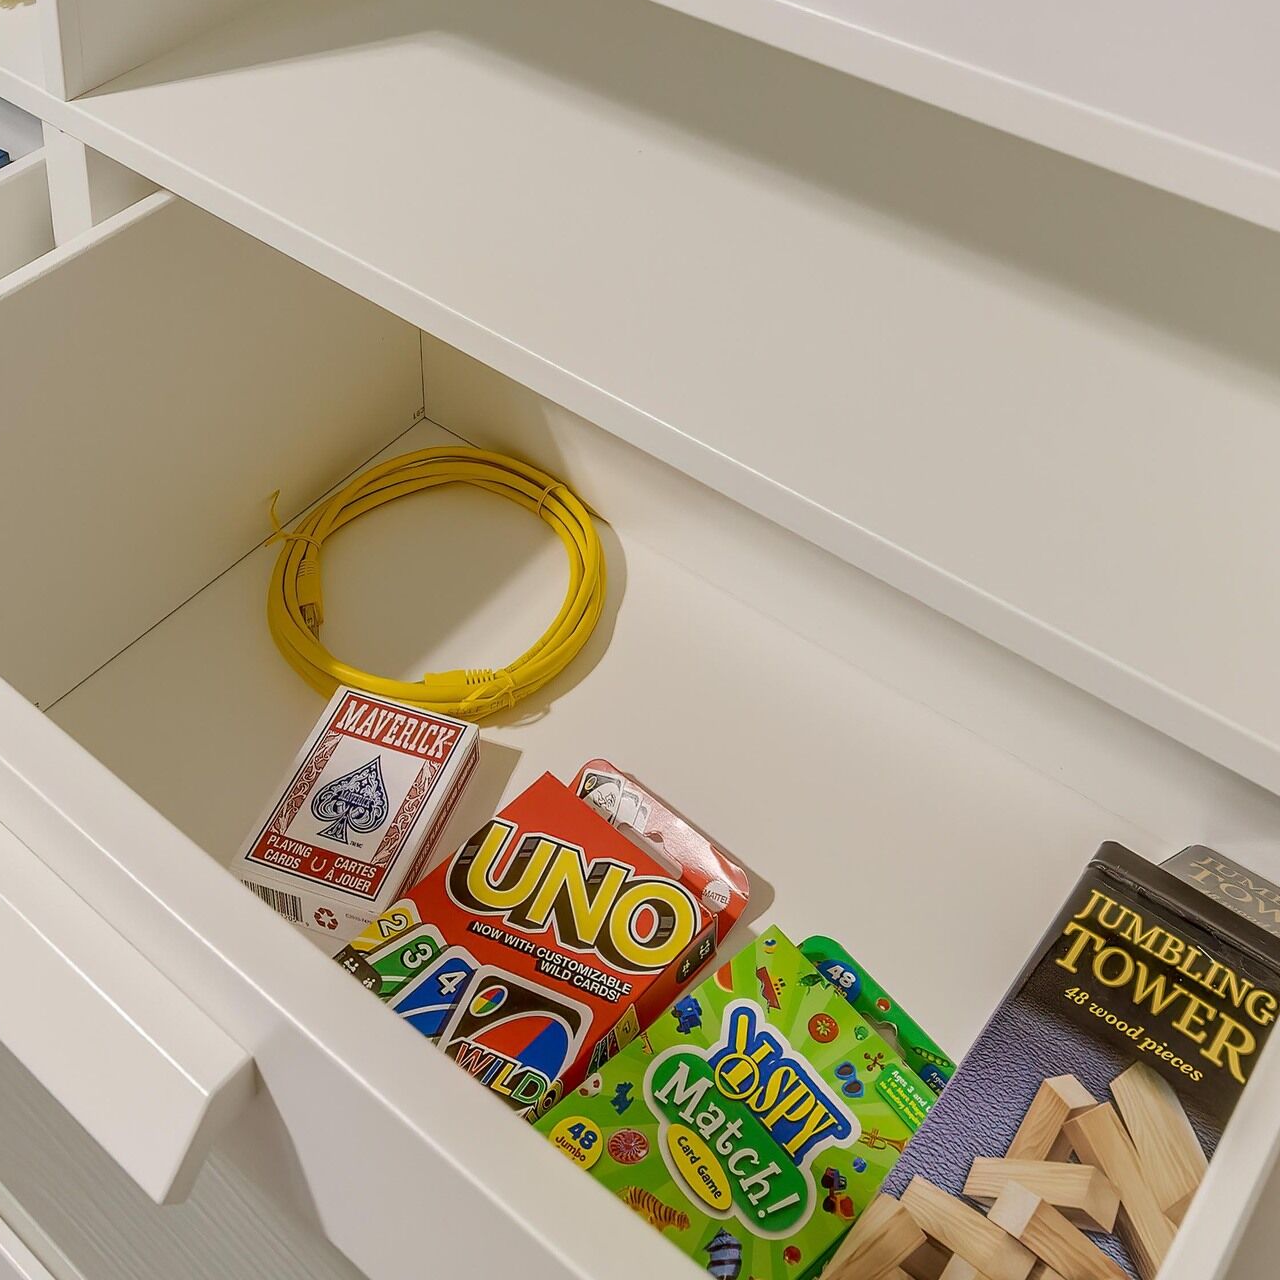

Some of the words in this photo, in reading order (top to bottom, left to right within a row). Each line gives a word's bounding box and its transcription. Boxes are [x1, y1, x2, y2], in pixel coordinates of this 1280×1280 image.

[335, 699, 456, 760] MAVERICK
[263, 848, 302, 870] CARDS
[267, 835, 312, 858] PLAYING
[323, 866, 334, 882] À
[334, 873, 372, 893] JOUER
[334, 856, 377, 879] CARTES
[465, 820, 696, 968] UNO
[703, 887, 729, 904] MATTEL
[378, 913, 408, 937] 2
[401, 942, 433, 969] 3
[472, 921, 503, 941] NOW
[504, 931, 535, 953] WITH
[537, 941, 632, 996] CUSTOMIZABLE
[1073, 888, 1278, 1026] JUMBLING
[437, 971, 468, 995] 4
[540, 960, 572, 982] WILD
[573, 974, 620, 1003] CARDS!
[826, 964, 856, 988] 48
[1055, 920, 1257, 1085] TOWER
[1064, 986, 1089, 1006] 48
[1089, 1001, 1145, 1041] wood
[1137, 1037, 1204, 1083] pieces
[454, 1042, 547, 1105] WILD
[891, 1070, 907, 1088] Ages
[913, 1094, 928, 1107] and
[746, 1066, 839, 1158] SPY
[555, 1135, 586, 1163] Jumbo
[568, 1122, 598, 1151] 48
[655, 1061, 801, 1218] Match!
[677, 1135, 700, 1166] Card
[696, 1165, 722, 1200] Game
